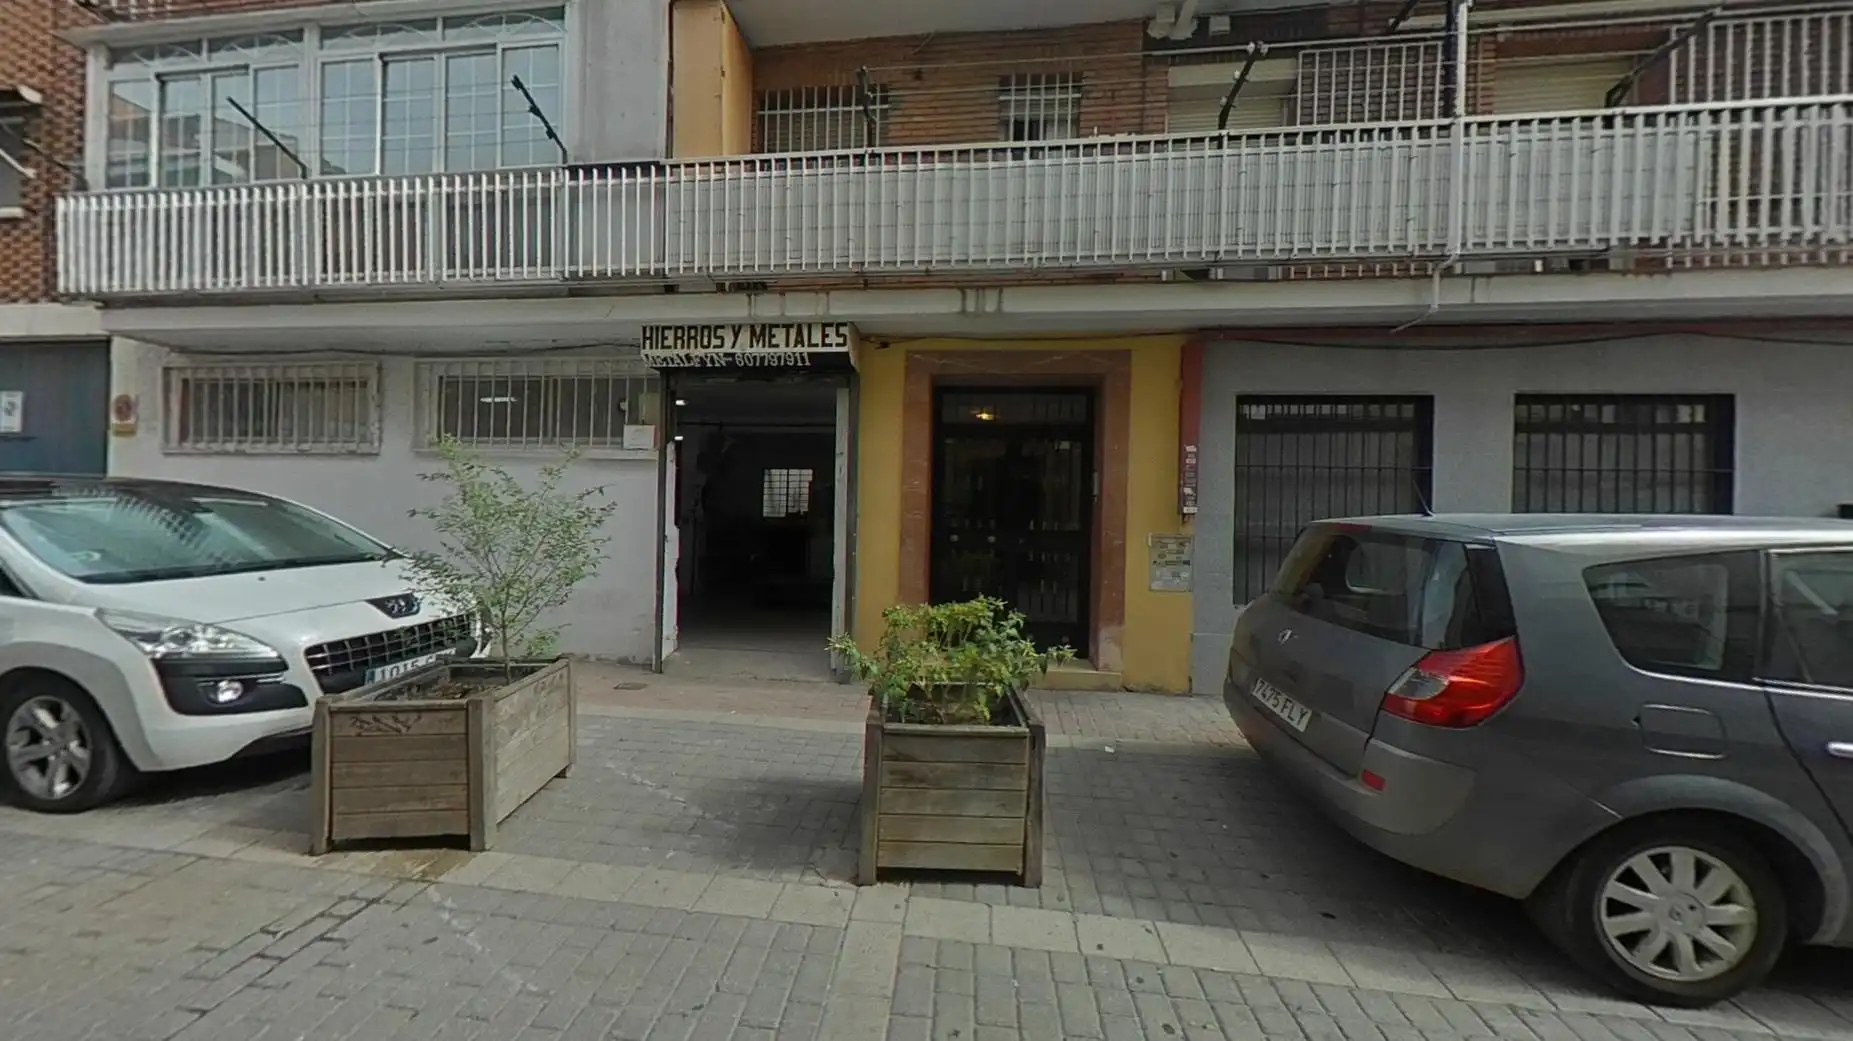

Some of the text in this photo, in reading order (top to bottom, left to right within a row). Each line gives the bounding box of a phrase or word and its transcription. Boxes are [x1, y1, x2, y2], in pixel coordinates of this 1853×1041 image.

[642, 322, 848, 350] HIERROS Y METALES
[1255, 679, 1309, 725] 7475 FLY
